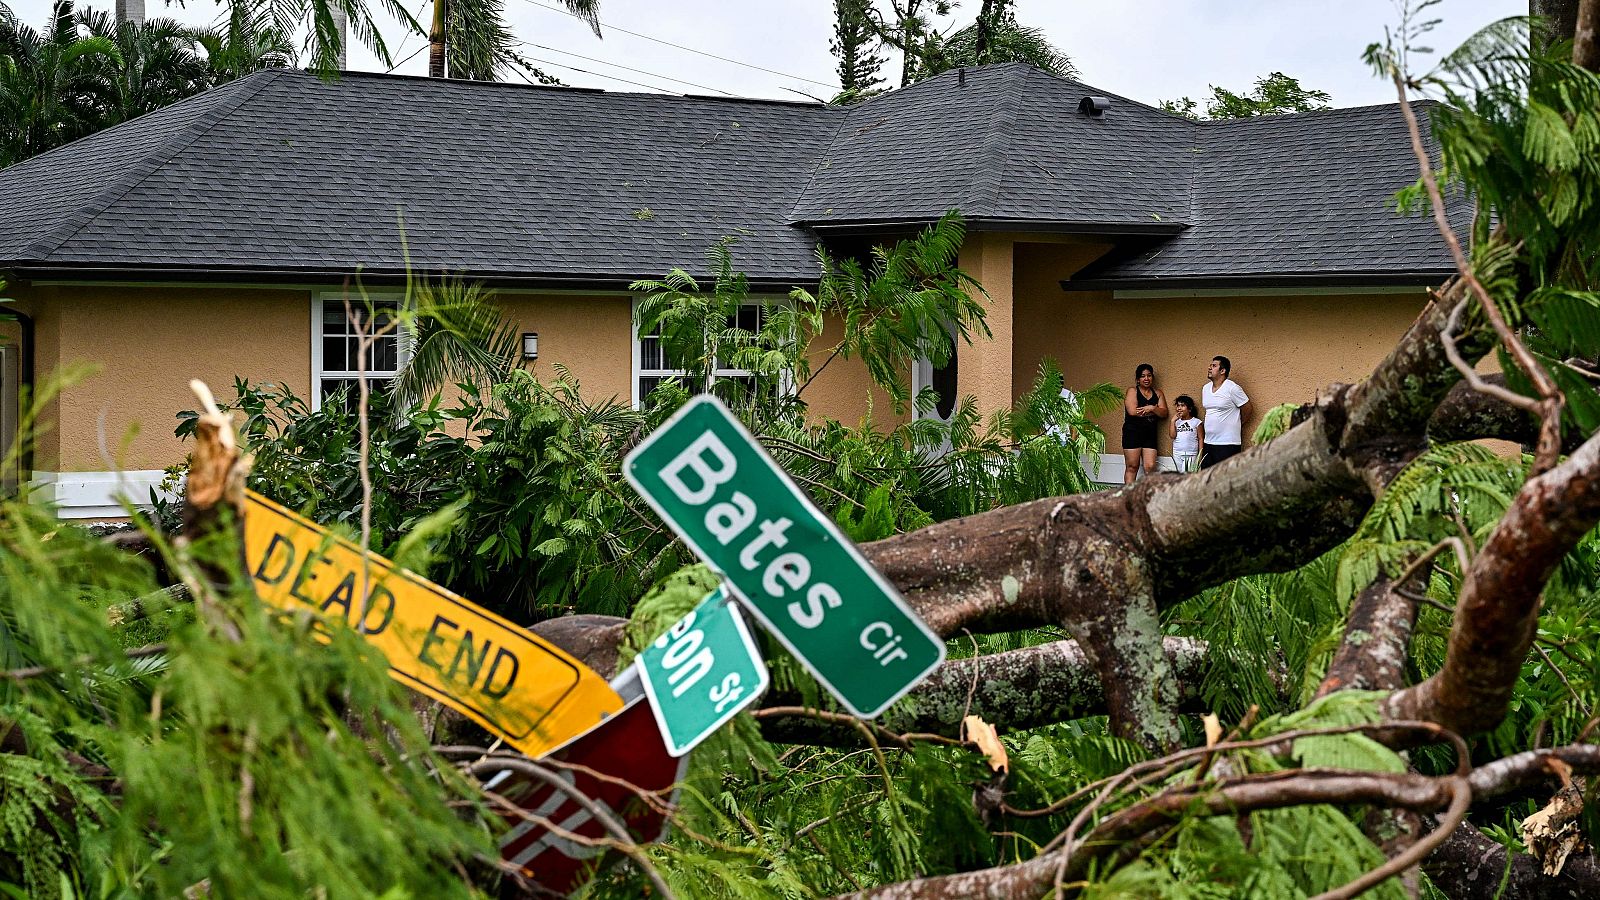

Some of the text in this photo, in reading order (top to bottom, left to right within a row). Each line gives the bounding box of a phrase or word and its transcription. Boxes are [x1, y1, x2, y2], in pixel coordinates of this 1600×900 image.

[253, 532, 520, 701] DEAD END
[657, 428, 908, 667] Bates Cir
[708, 671, 745, 714] St
